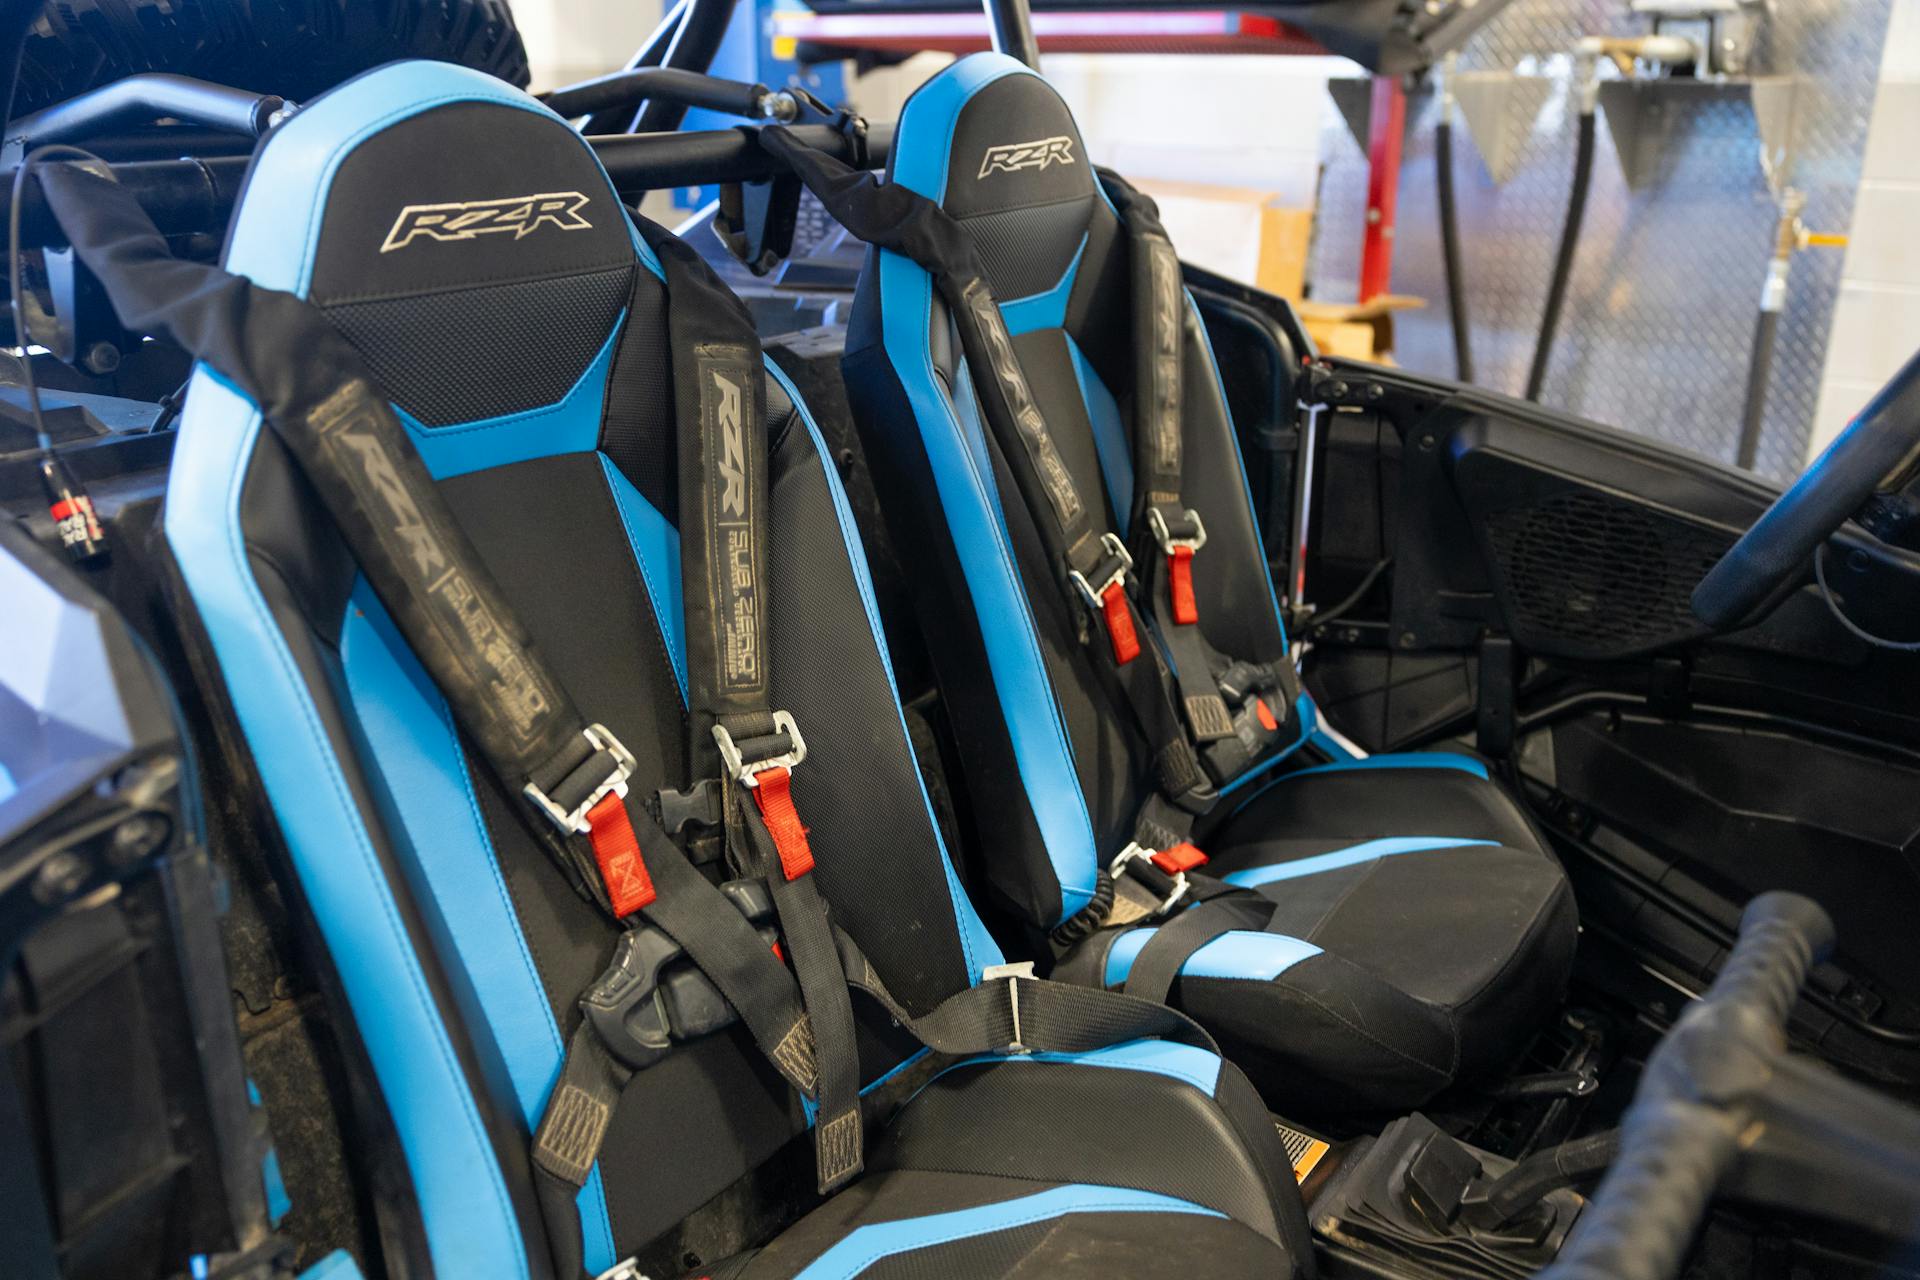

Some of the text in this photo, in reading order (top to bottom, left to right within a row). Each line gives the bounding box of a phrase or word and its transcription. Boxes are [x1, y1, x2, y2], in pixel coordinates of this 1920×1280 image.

[380, 191, 593, 253] RZR
[978, 136, 1075, 179] RZR
[340, 434, 444, 577] RZR
[713, 372, 745, 517] RZR
[453, 576, 492, 636] SUB
[491, 638, 546, 711] ZERO
[734, 531, 755, 673] SUB ZERO
